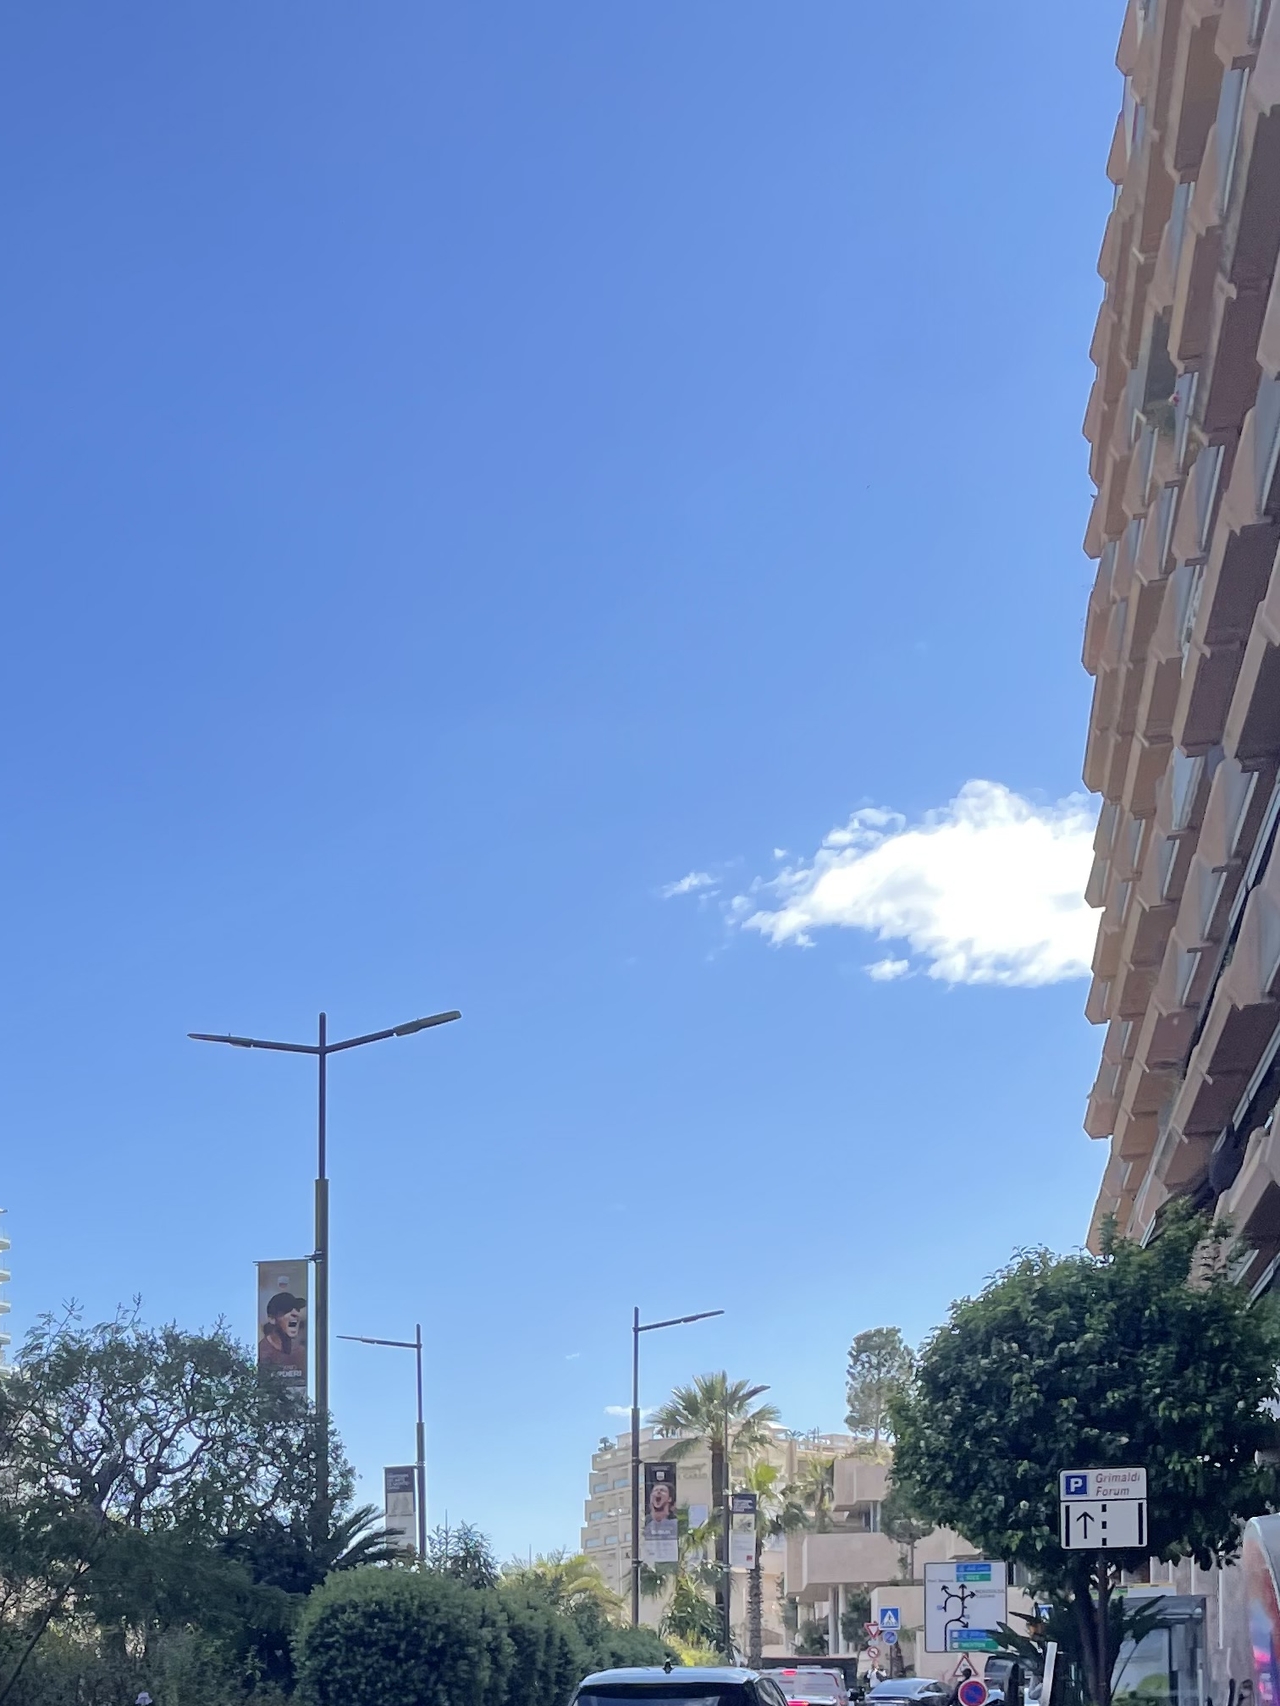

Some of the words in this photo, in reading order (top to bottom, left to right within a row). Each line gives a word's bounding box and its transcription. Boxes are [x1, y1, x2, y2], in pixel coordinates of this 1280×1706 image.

[1070, 1477, 1083, 1492] P
[1095, 1472, 1140, 1484] Grimaldi
[1096, 1486, 1130, 1497] Forum
